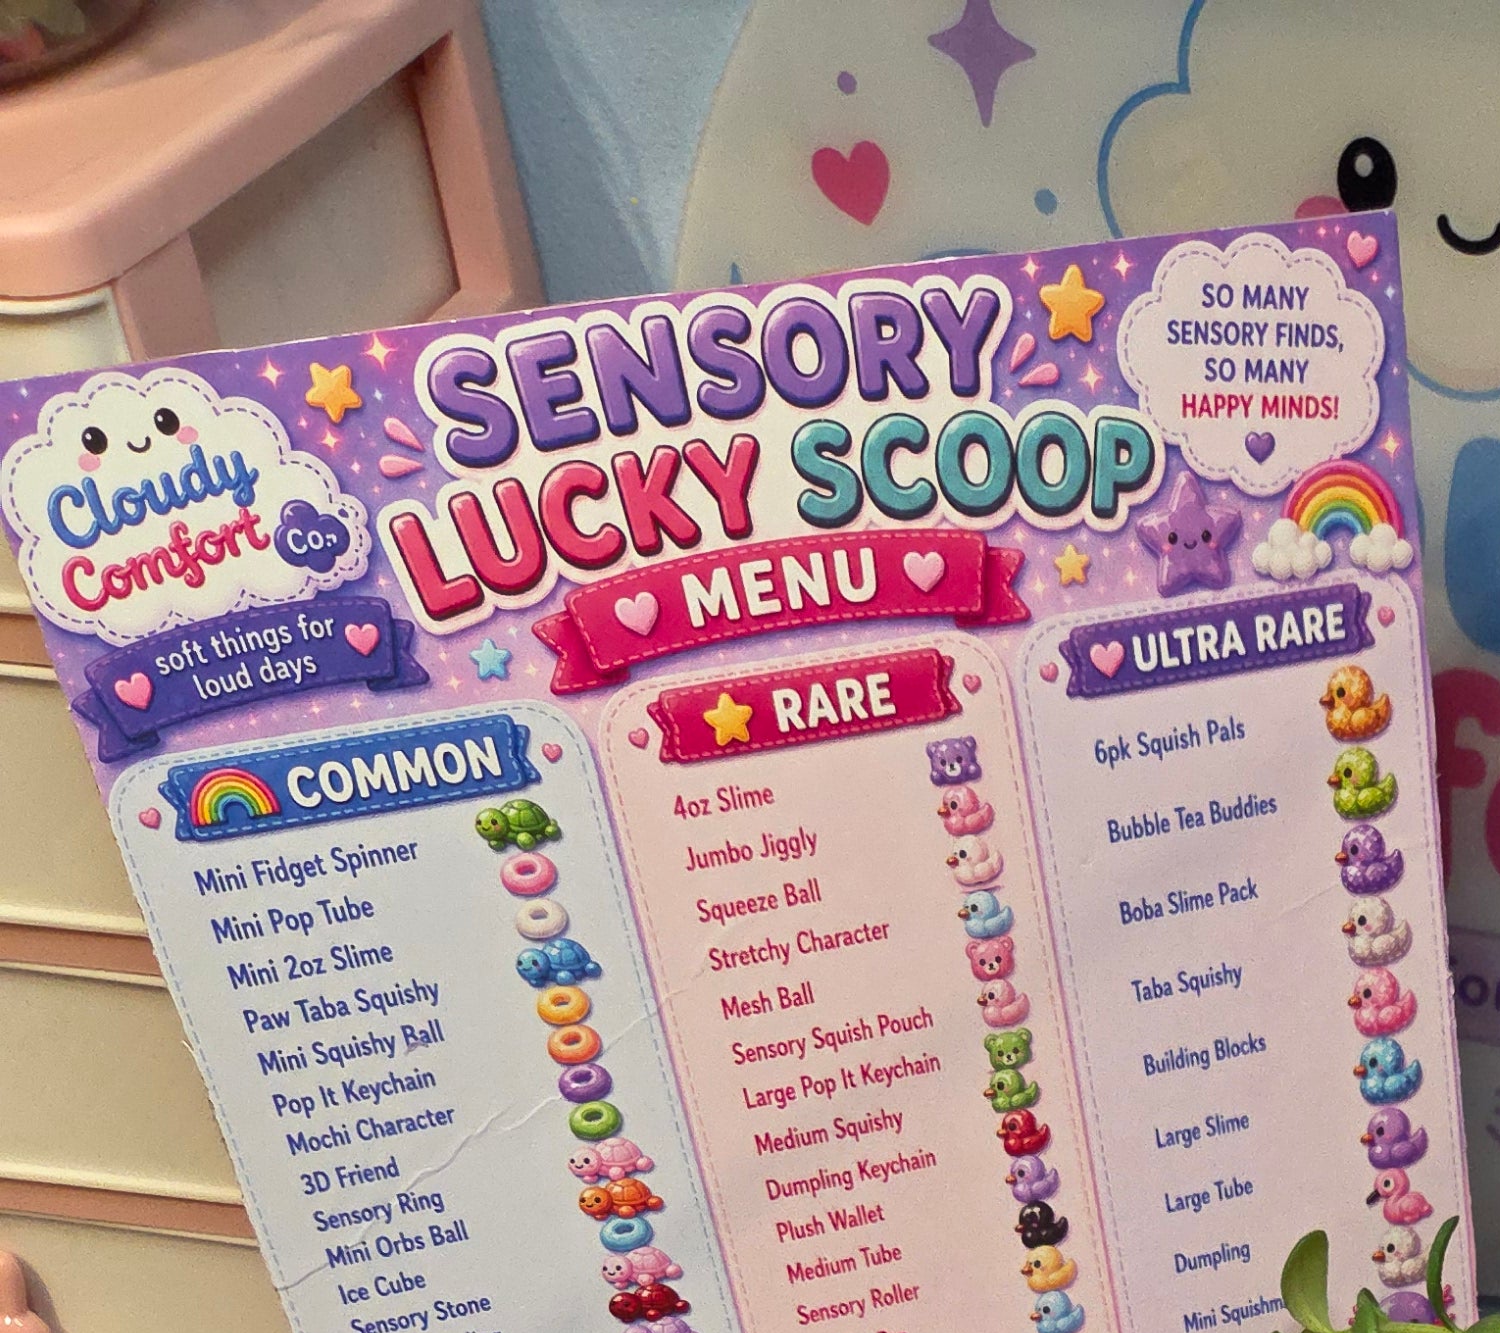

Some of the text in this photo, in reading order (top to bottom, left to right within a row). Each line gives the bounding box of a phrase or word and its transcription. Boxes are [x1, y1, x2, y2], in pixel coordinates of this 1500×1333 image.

[1202, 283, 1309, 311] SO MANY
[1167, 320, 1344, 353] SENSORY FINDS,
[429, 287, 1000, 469] SENSORY
[1204, 358, 1309, 384] SO MANY
[1181, 394, 1339, 420] HAPPY MINDS!
[47, 444, 260, 549] Cloudy
[389, 409, 1155, 619] LUCKY SCOOP
[62, 507, 271, 612] Comfort
[680, 547, 878, 628] MENU
[155, 613, 334, 676] soft things for
[1133, 603, 1346, 673] ULTRA RARE
[193, 653, 318, 700] loud days
[772, 672, 896, 733] RARE
[1095, 715, 1246, 770] 6pk Squish Pals
[287, 736, 502, 807] COMMON
[673, 785, 775, 819] 4oz Slime
[1108, 795, 1278, 843] Bubble Tea Buddies
[194, 841, 419, 895] Mini Fidget Spinner
[686, 826, 817, 871] Jumbo Jiggly
[211, 896, 374, 943] Mini Pop Tube
[696, 878, 822, 925] Squeeze Ball
[1120, 877, 1259, 925] Boba Slime Pack
[227, 943, 393, 990] Mini 2oz Slime
[709, 920, 891, 971] Stretchy Character
[243, 979, 439, 1033] Paw Taba Squishy
[720, 981, 815, 1020] Mesh Ball
[1132, 963, 1243, 1002] Taba Squishy
[257, 1019, 445, 1076] Mini Squishy Ball
[732, 1007, 934, 1065] Sensory Squish Pouch
[1143, 1033, 1266, 1076] Building Blocks
[272, 1069, 437, 1117] Pop It Keychain
[743, 1053, 941, 1110] Large Pop It Keychain
[286, 1106, 456, 1156] Mochi Character
[754, 1109, 903, 1156] Medium Squishy
[1155, 1111, 1250, 1150] Large Slime
[300, 1156, 401, 1195] 3D Friend
[765, 1149, 937, 1201] Dumpling Keychain
[1165, 1177, 1254, 1214] Large Tube
[313, 1190, 445, 1233] Sensory Ring
[776, 1204, 885, 1243] Plush Wallet
[325, 1219, 470, 1268] Mini Orbs Ball
[786, 1244, 902, 1284] Medium Tube
[1174, 1241, 1251, 1275] Dumpling
[337, 1270, 426, 1306] Ice Cube
[434, 1294, 491, 1321] Stone
[797, 1283, 920, 1325] Sensory Roller
[1184, 1295, 1286, 1333] Mini Squishm
